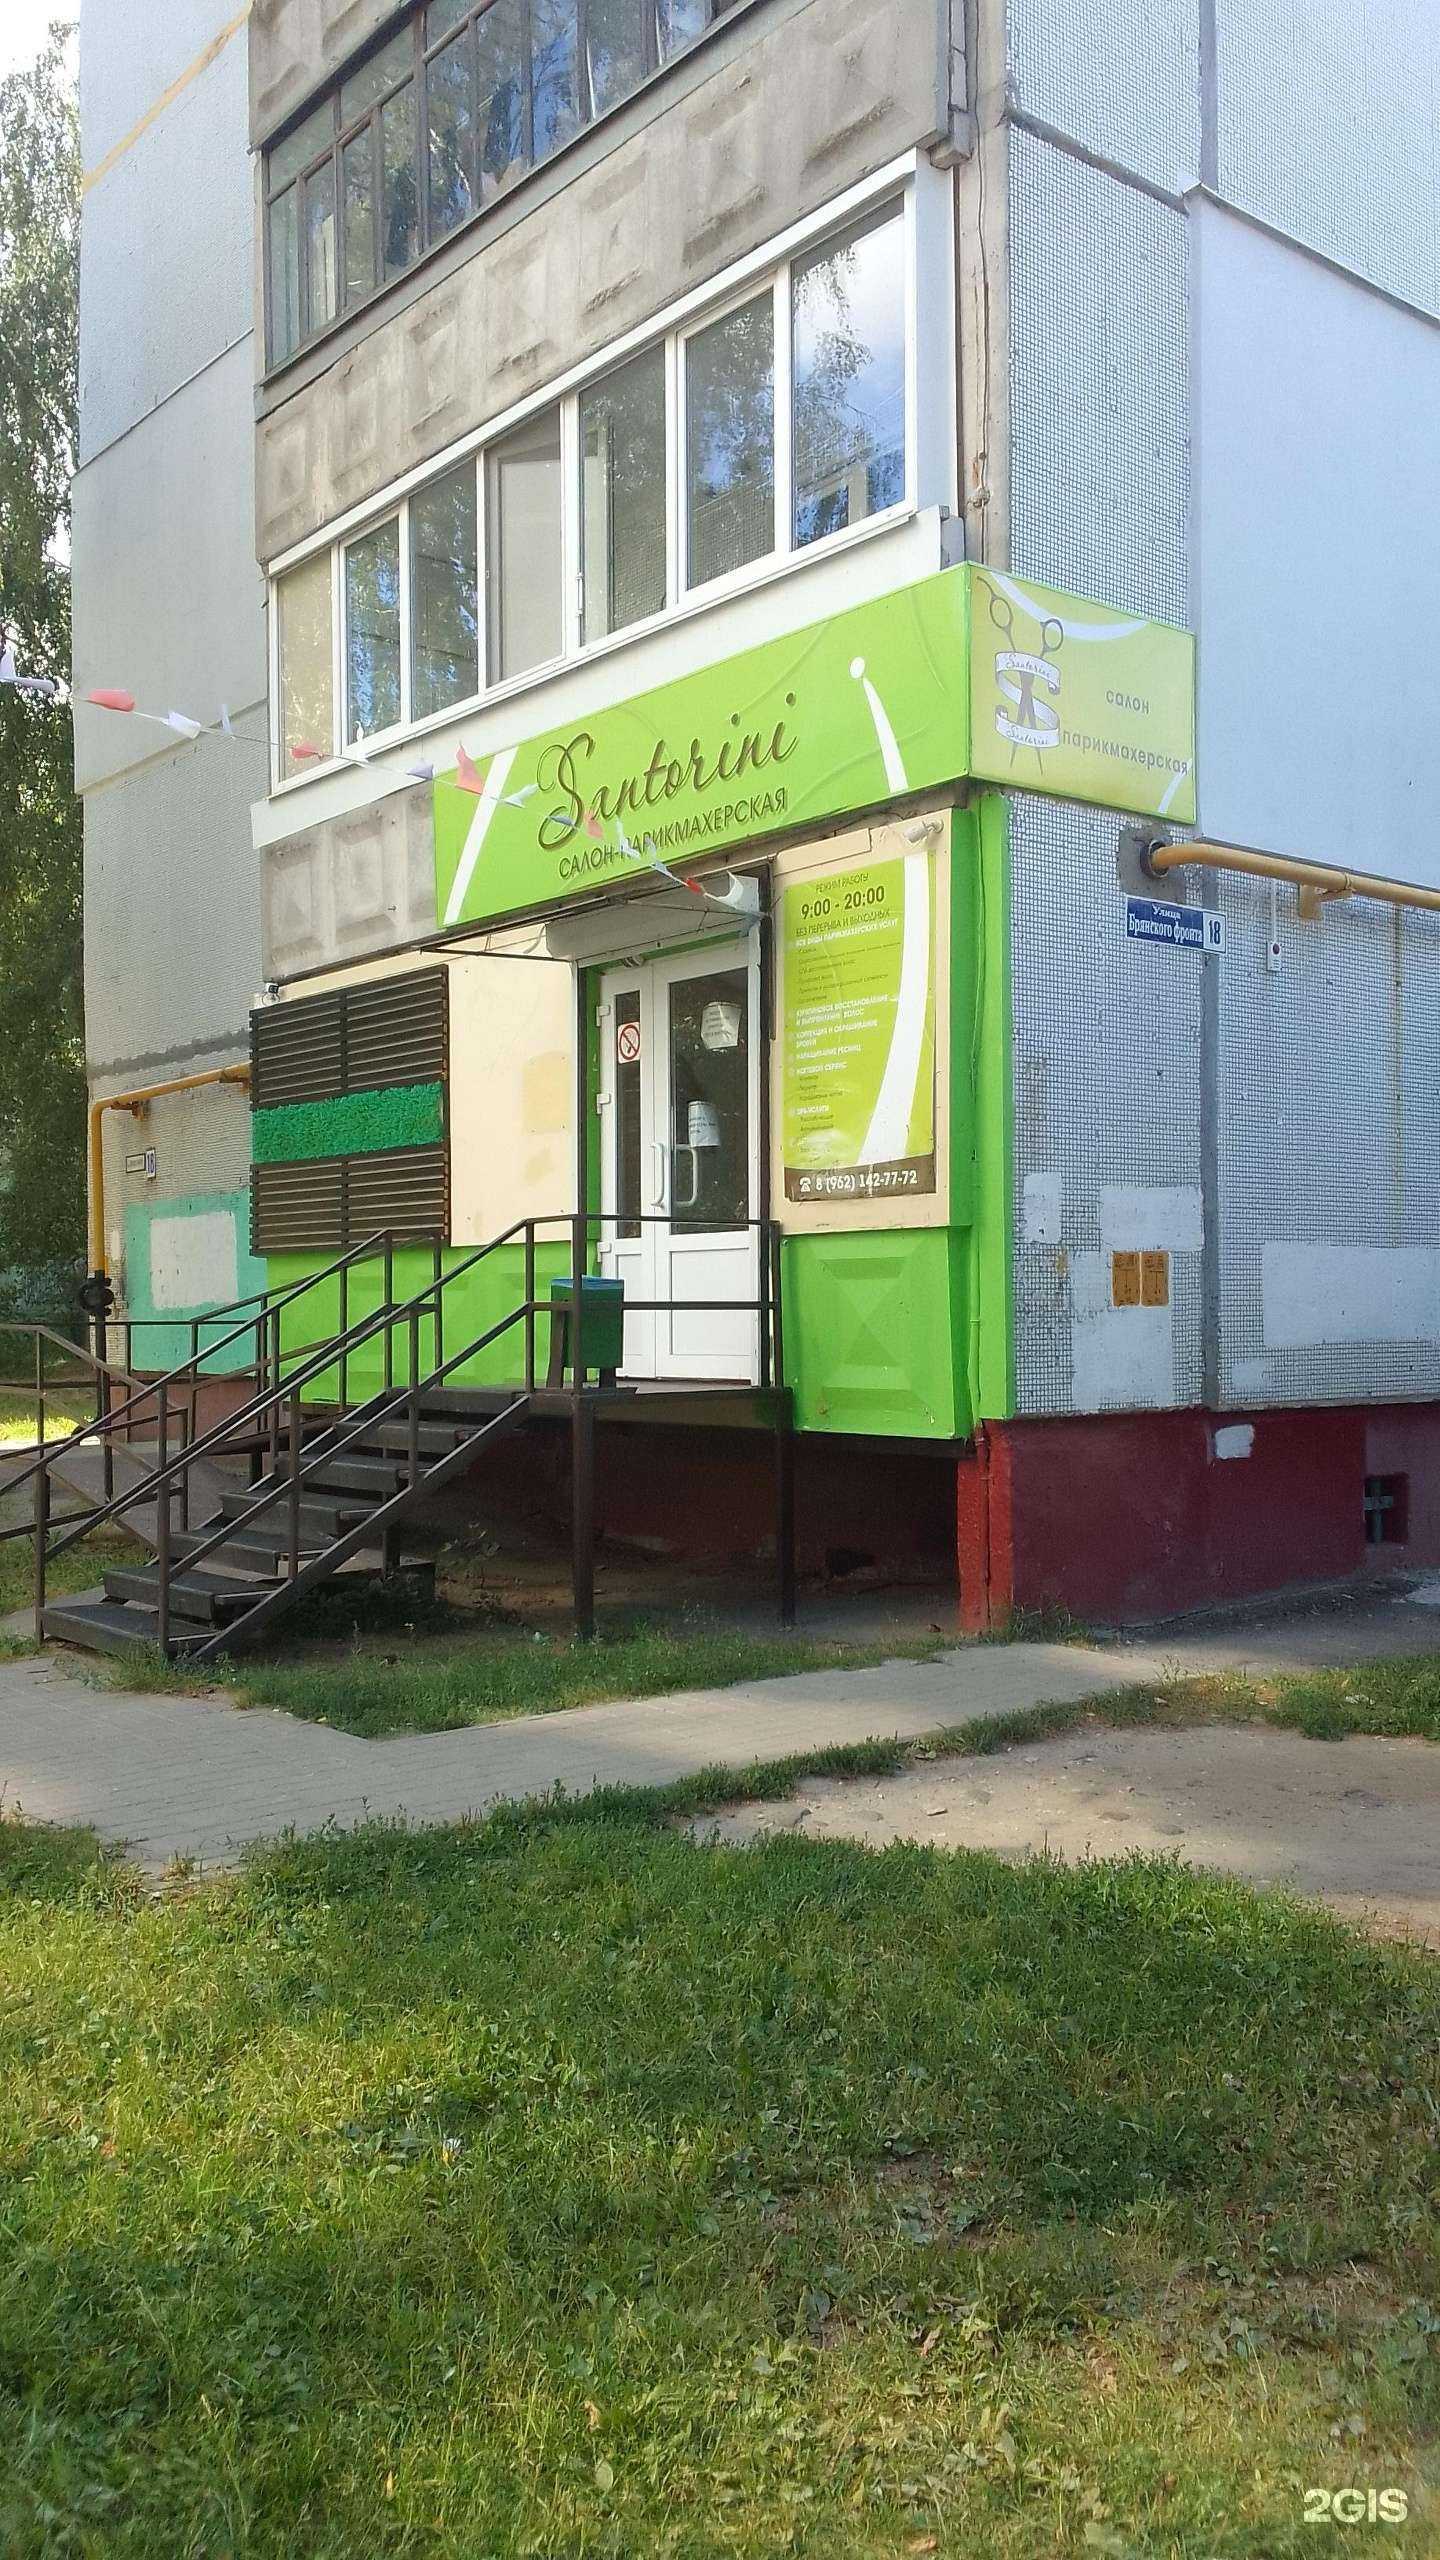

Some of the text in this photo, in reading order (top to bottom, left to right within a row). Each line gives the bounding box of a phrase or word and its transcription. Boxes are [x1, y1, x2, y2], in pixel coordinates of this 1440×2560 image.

[1106, 688, 1150, 715] салон
[1062, 730, 1188, 776] парикмахерская
[537, 691, 798, 850] Santorini
[801, 899, 831, 920] 9:00
[844, 886, 885, 910] 20:00
[1129, 912, 1173, 938] Брянского
[1209, 920, 1220, 945] 18
[816, 1181, 823, 1190] 8
